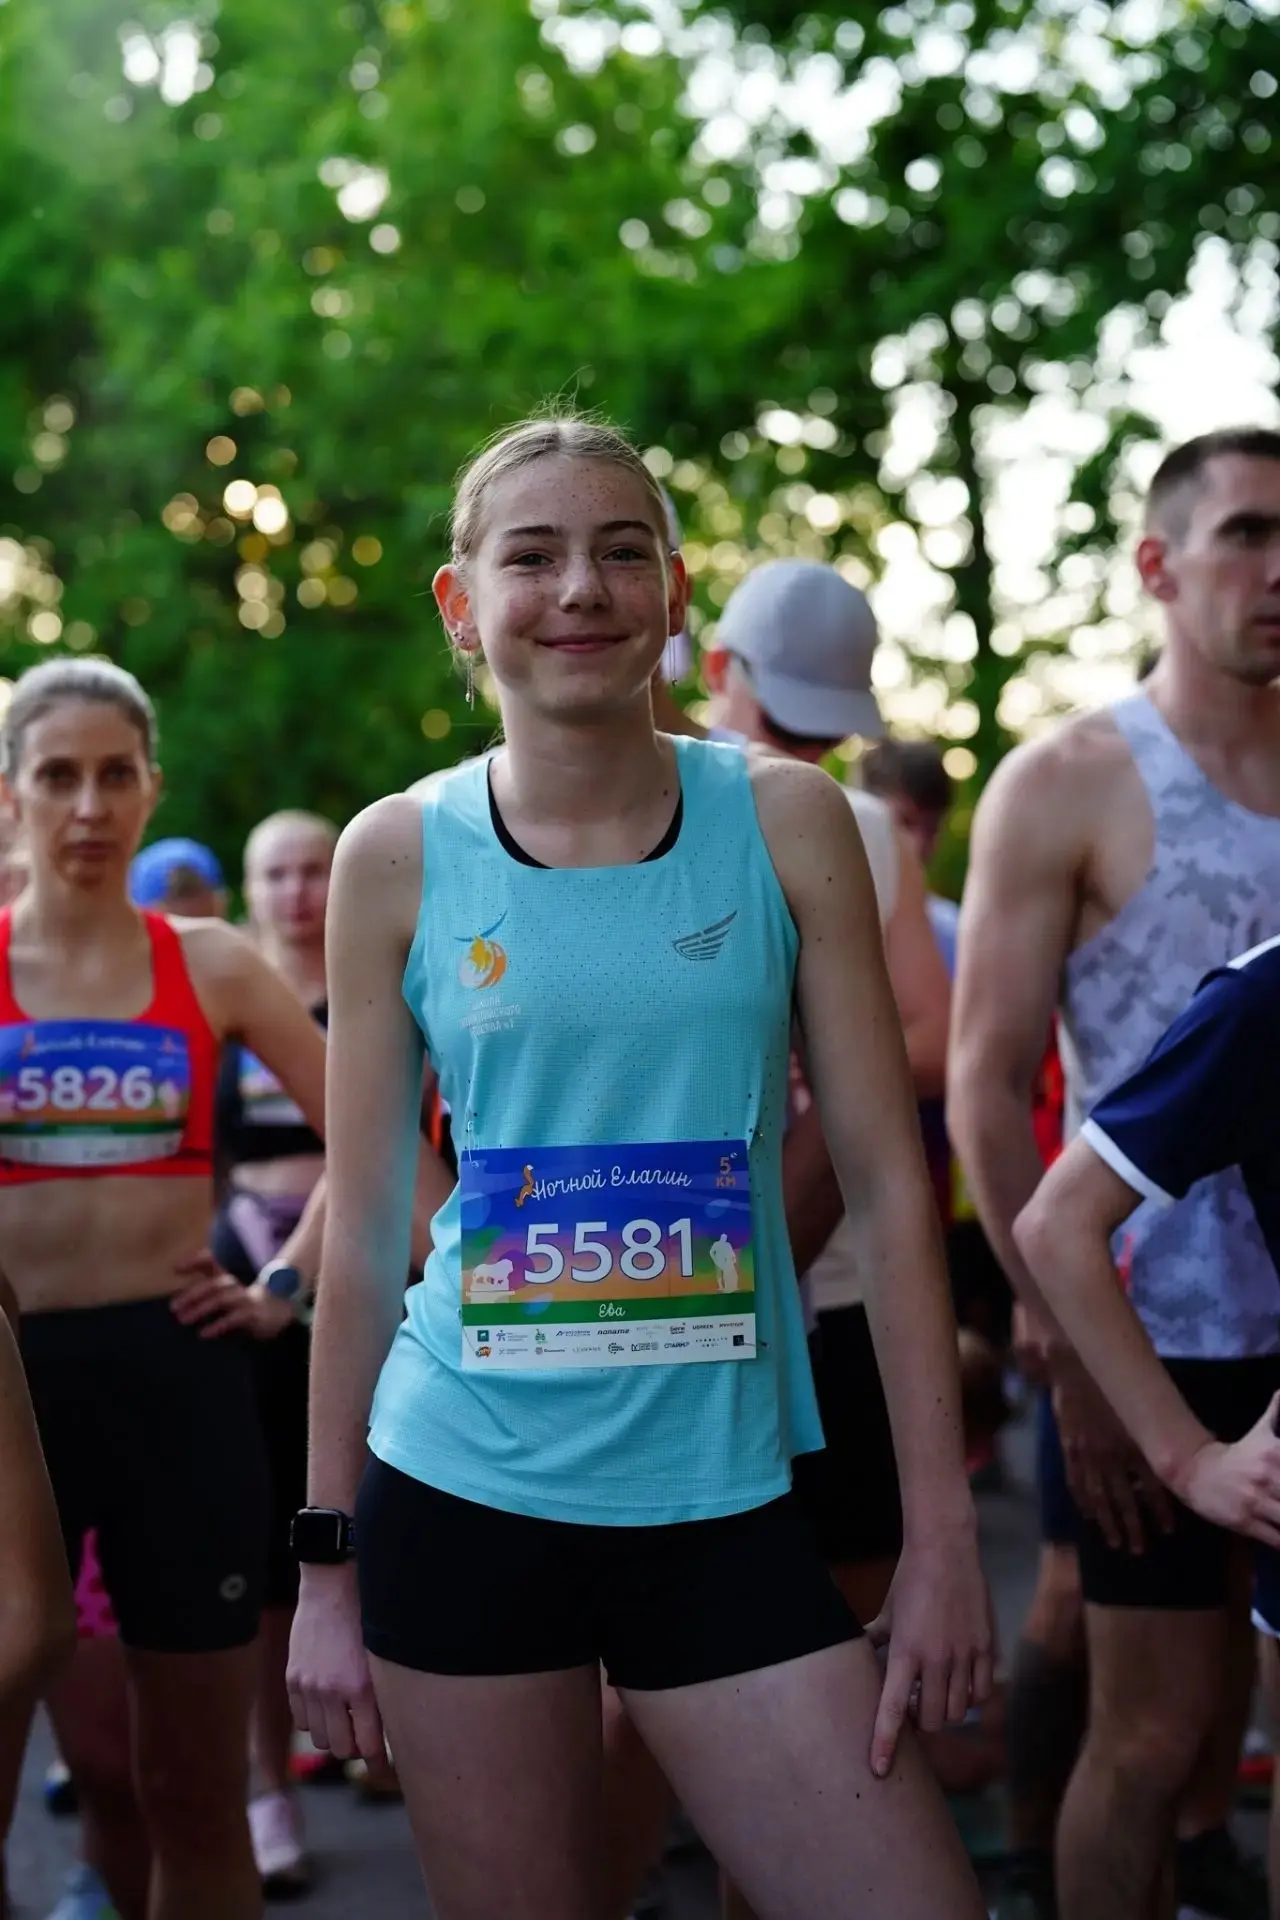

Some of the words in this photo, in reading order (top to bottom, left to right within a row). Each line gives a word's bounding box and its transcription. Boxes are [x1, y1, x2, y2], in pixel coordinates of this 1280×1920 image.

[17, 1065, 155, 1111] 5826
[531, 1169, 607, 1200] Ночной
[611, 1165, 693, 1187] Елагин
[719, 1156, 731, 1175] 5
[524, 1217, 694, 1285] 5581
[598, 1301, 626, 1318] Ева
